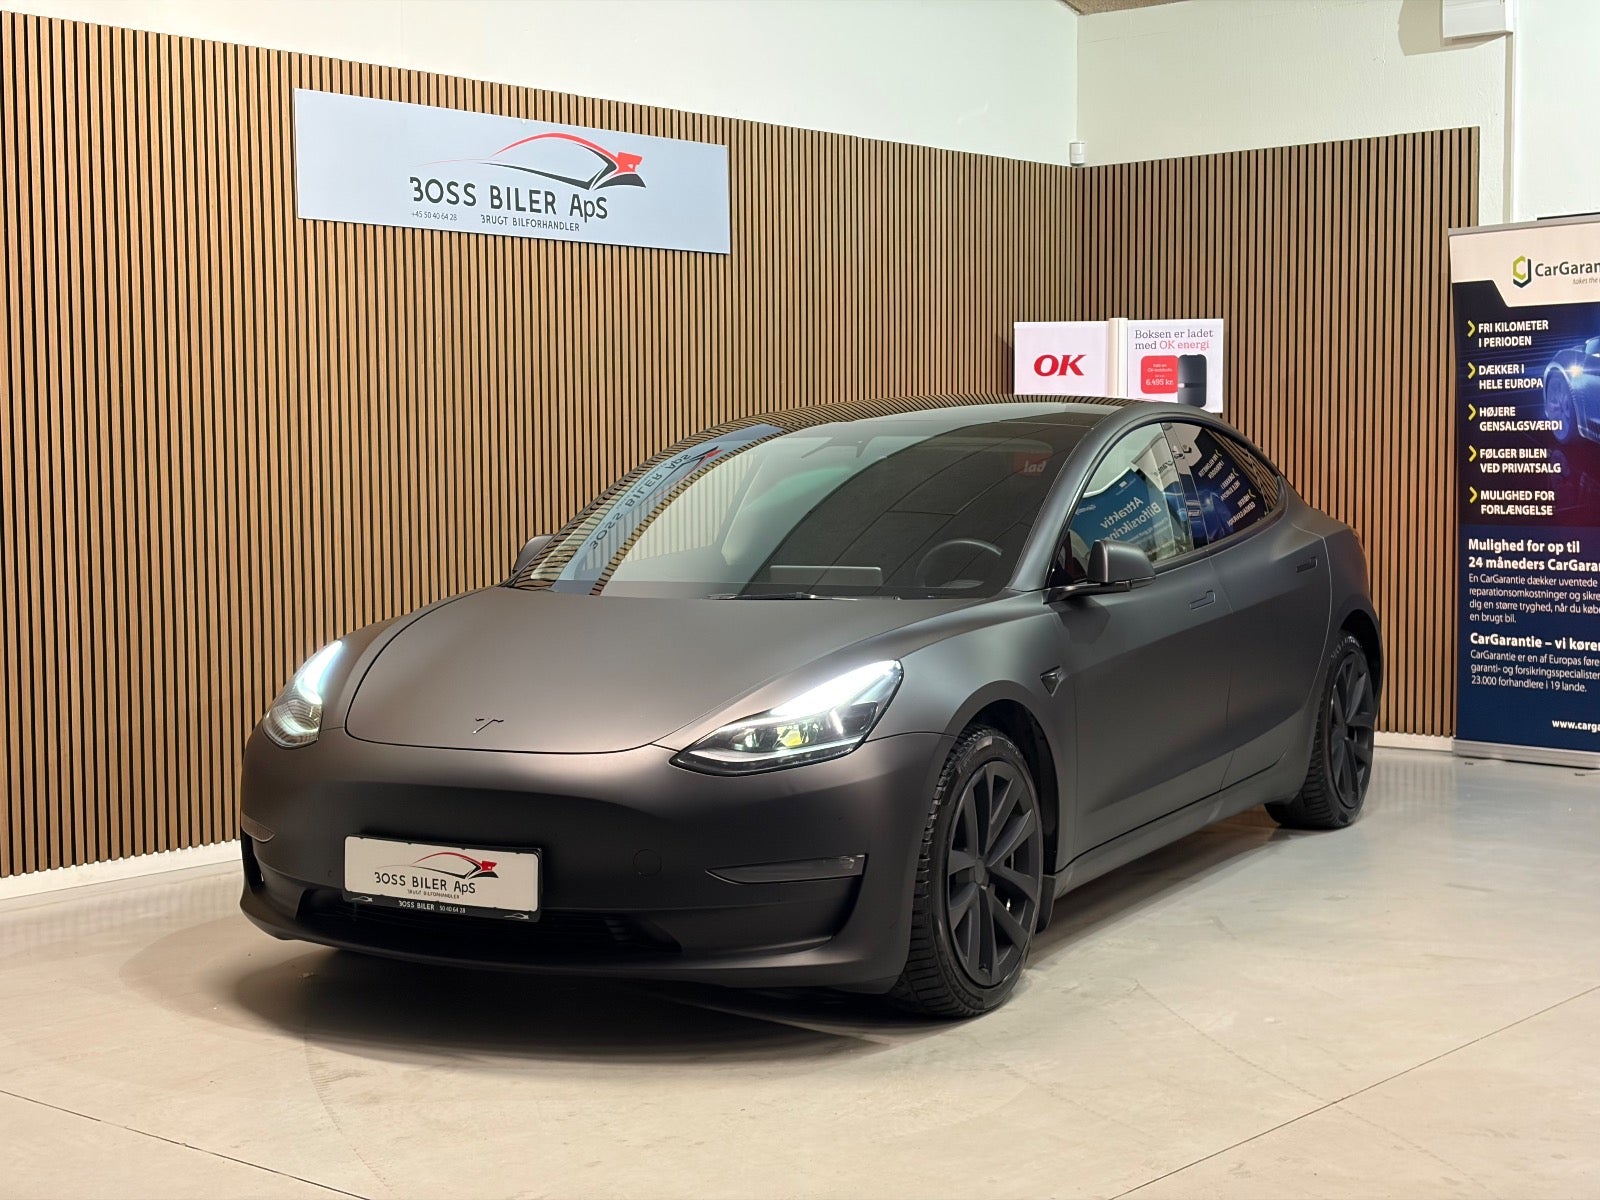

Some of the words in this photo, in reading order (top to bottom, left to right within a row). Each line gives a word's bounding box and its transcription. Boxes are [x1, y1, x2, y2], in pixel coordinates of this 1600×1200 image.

[490, 185, 556, 214] BILER
[570, 194, 608, 223] ApS
[412, 210, 422, 218] +45
[424, 211, 432, 219] 50
[513, 218, 580, 231] BILFORHANDLER
[1535, 261, 1600, 276] CarGaran
[1479, 323, 1492, 333] FRI
[1495, 320, 1549, 332] KILOMETER
[1135, 330, 1171, 338] Boksen
[1188, 329, 1214, 338] ladet
[1135, 341, 1156, 349] med
[1160, 340, 1175, 349] OK
[1178, 340, 1210, 351] energi
[1479, 338, 1481, 347] I
[1484, 336, 1532, 347] PERIODEN
[1034, 354, 1086, 376] OK
[1479, 364, 1519, 375] DÆKKER
[1522, 364, 1524, 374] I
[1480, 379, 1502, 389] HELE
[1505, 378, 1543, 389] EUROPA
[1480, 407, 1515, 417] HØJERE
[1480, 420, 1562, 431] GENSALGSVÆRDI
[1480, 448, 1517, 459] FØLGER
[1519, 448, 1546, 458] BILEN
[1480, 463, 1500, 473] VED
[1502, 463, 1561, 473] PRIVATSALG
[1481, 490, 1532, 500] MULIGHED
[1535, 491, 1555, 500] FOR
[1481, 505, 1553, 515] FORLÆNGELSE
[1468, 539, 1524, 553] Mulighed
[1527, 540, 1545, 552] for
[1548, 543, 1564, 555] op
[1567, 541, 1579, 553] til
[1469, 557, 1483, 568] 24
[1486, 556, 1545, 570] måneders
[1548, 559, 1600, 571] CarGara
[1469, 573, 1478, 582] En
[1480, 574, 1525, 584] CarGarantie
[1527, 576, 1556, 585] dækker
[1559, 578, 1598, 587] uventede
[1470, 588, 1567, 601] reparationsomkostninger
[1569, 592, 1580, 602] og
[1583, 591, 1600, 600] sikre
[1470, 599, 1481, 610] dig
[1496, 601, 1518, 610] større
[1520, 602, 1552, 613] tryghed,
[1555, 603, 1568, 612] når
[1570, 603, 1580, 613] du
[1583, 604, 1600, 614] køb
[1482, 612, 1503, 624] brugt
[1505, 613, 1516, 623] bil.
[1470, 632, 1542, 648] CarGarantie
[1555, 637, 1566, 649] vi
[1471, 650, 1516, 661] CarGarantie
[1540, 654, 1547, 663] af
[1549, 654, 1581, 666] Europas
[1471, 664, 1501, 673] garanti-
[1503, 666, 1513, 676] og
[1472, 675, 1496, 685] 23.000
[1499, 677, 1544, 689] forhandlere
[1551, 681, 1560, 690] 19
[1562, 682, 1587, 692] lande.
[412, 876, 446, 891] BILER
[454, 881, 475, 895] ApS
[417, 902, 434, 910] BILER
